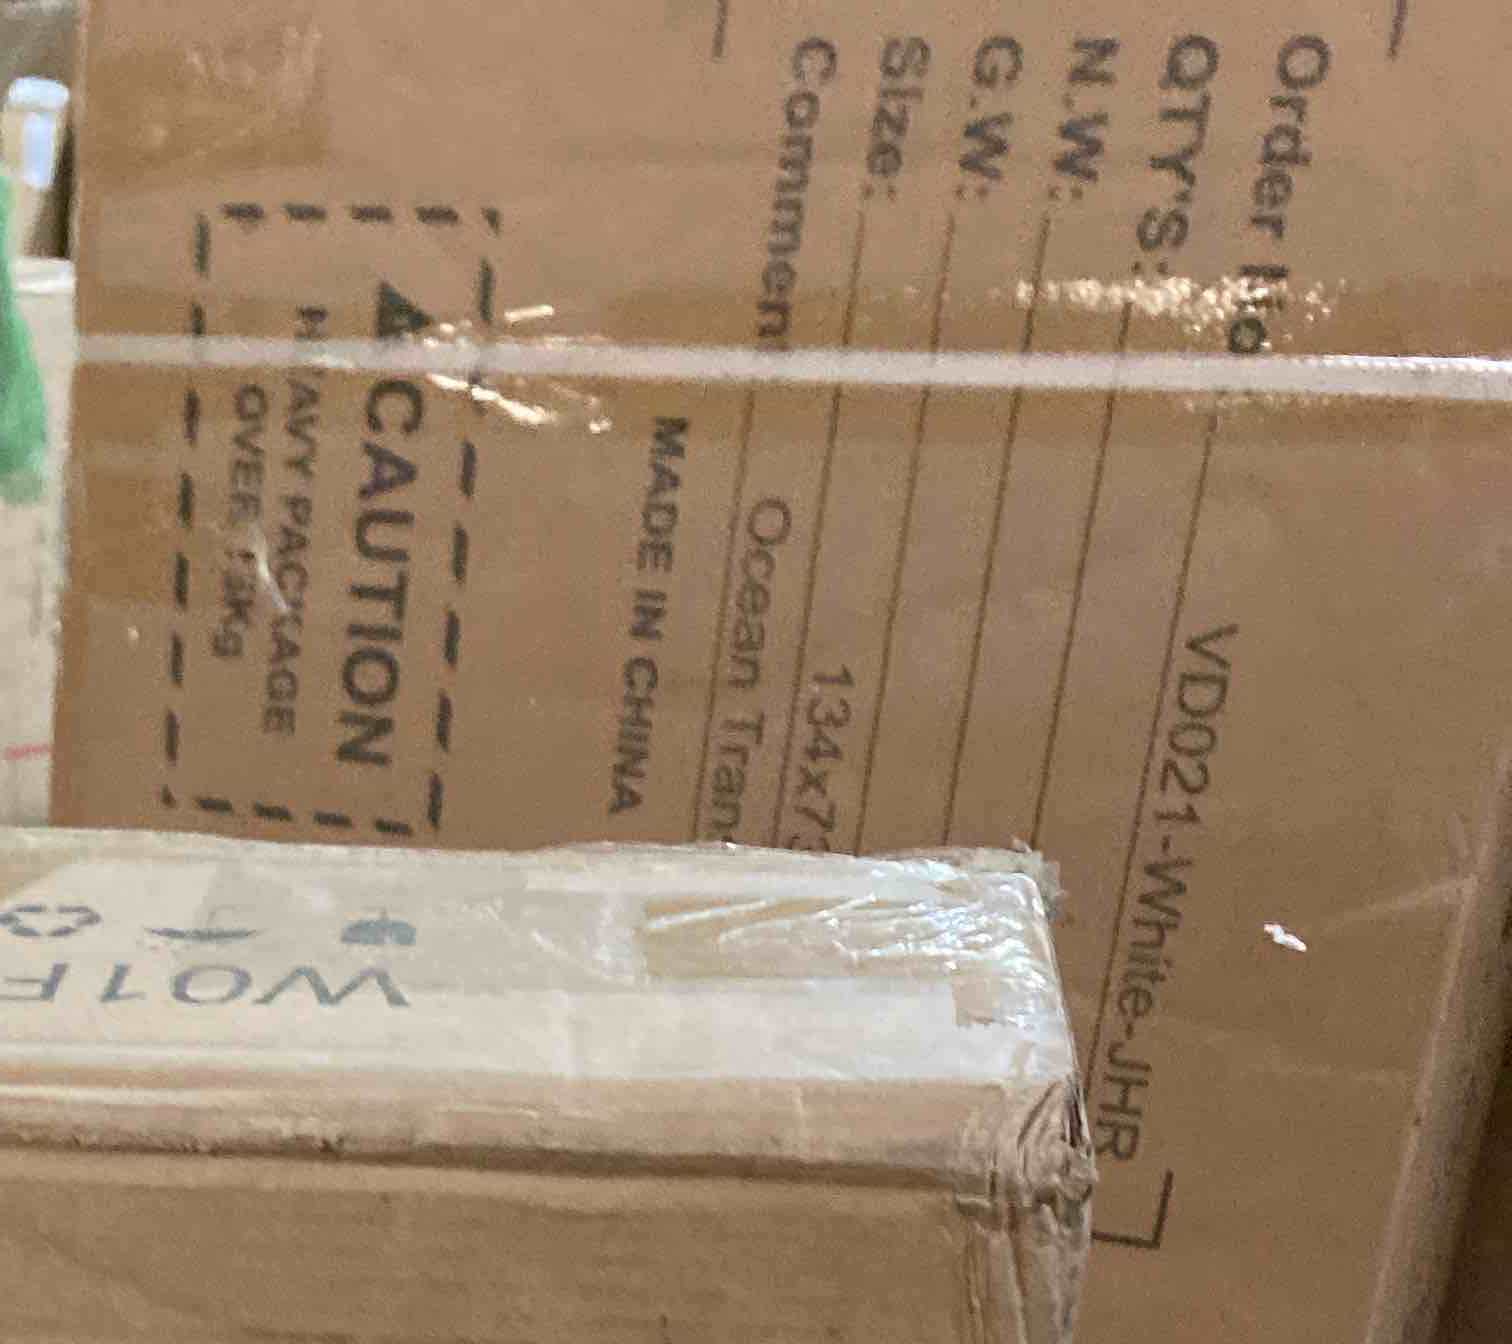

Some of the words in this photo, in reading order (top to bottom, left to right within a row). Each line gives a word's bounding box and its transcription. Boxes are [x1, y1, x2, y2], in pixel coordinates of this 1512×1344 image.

[757, 35, 838, 352] Commen
[864, 35, 932, 201] Size:
[955, 35, 1025, 201] G.W:
[1047, 38, 1120, 201] N.W:
[1249, 33, 1332, 240] Order
[230, 384, 269, 525] OVER
[285, 306, 328, 479] HAVY
[336, 378, 424, 768] CAUTION
[636, 416, 688, 575] MADE
[263, 496, 313, 736] PACKAGE
[631, 591, 669, 642] IN
[729, 497, 793, 691] Ocean
[609, 656, 660, 816] CHINA
[710, 714, 766, 847] Tran
[1095, 624, 1240, 1162] VD021-White-JHR
